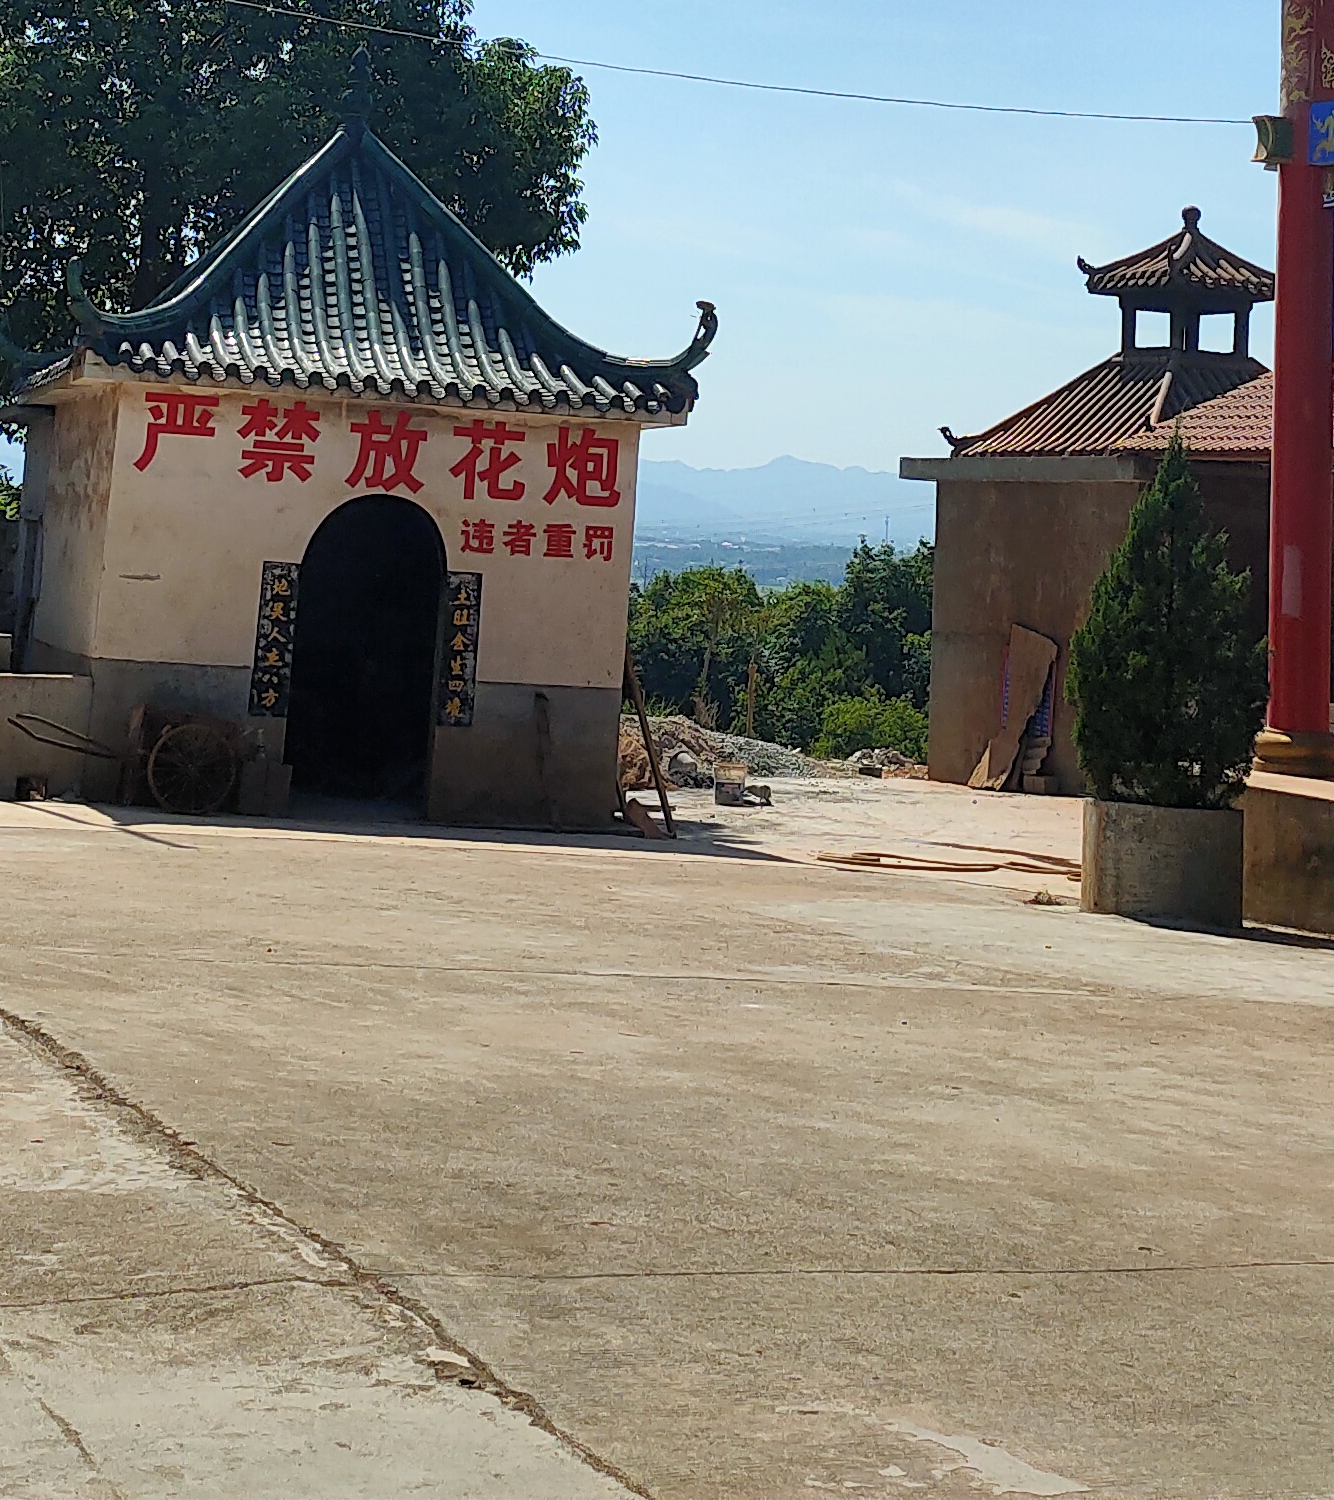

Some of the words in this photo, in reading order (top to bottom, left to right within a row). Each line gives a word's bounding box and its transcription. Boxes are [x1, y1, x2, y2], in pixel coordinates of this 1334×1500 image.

[133, 391, 621, 507] 严禁放花炮
[460, 518, 615, 562] 违者重罚
